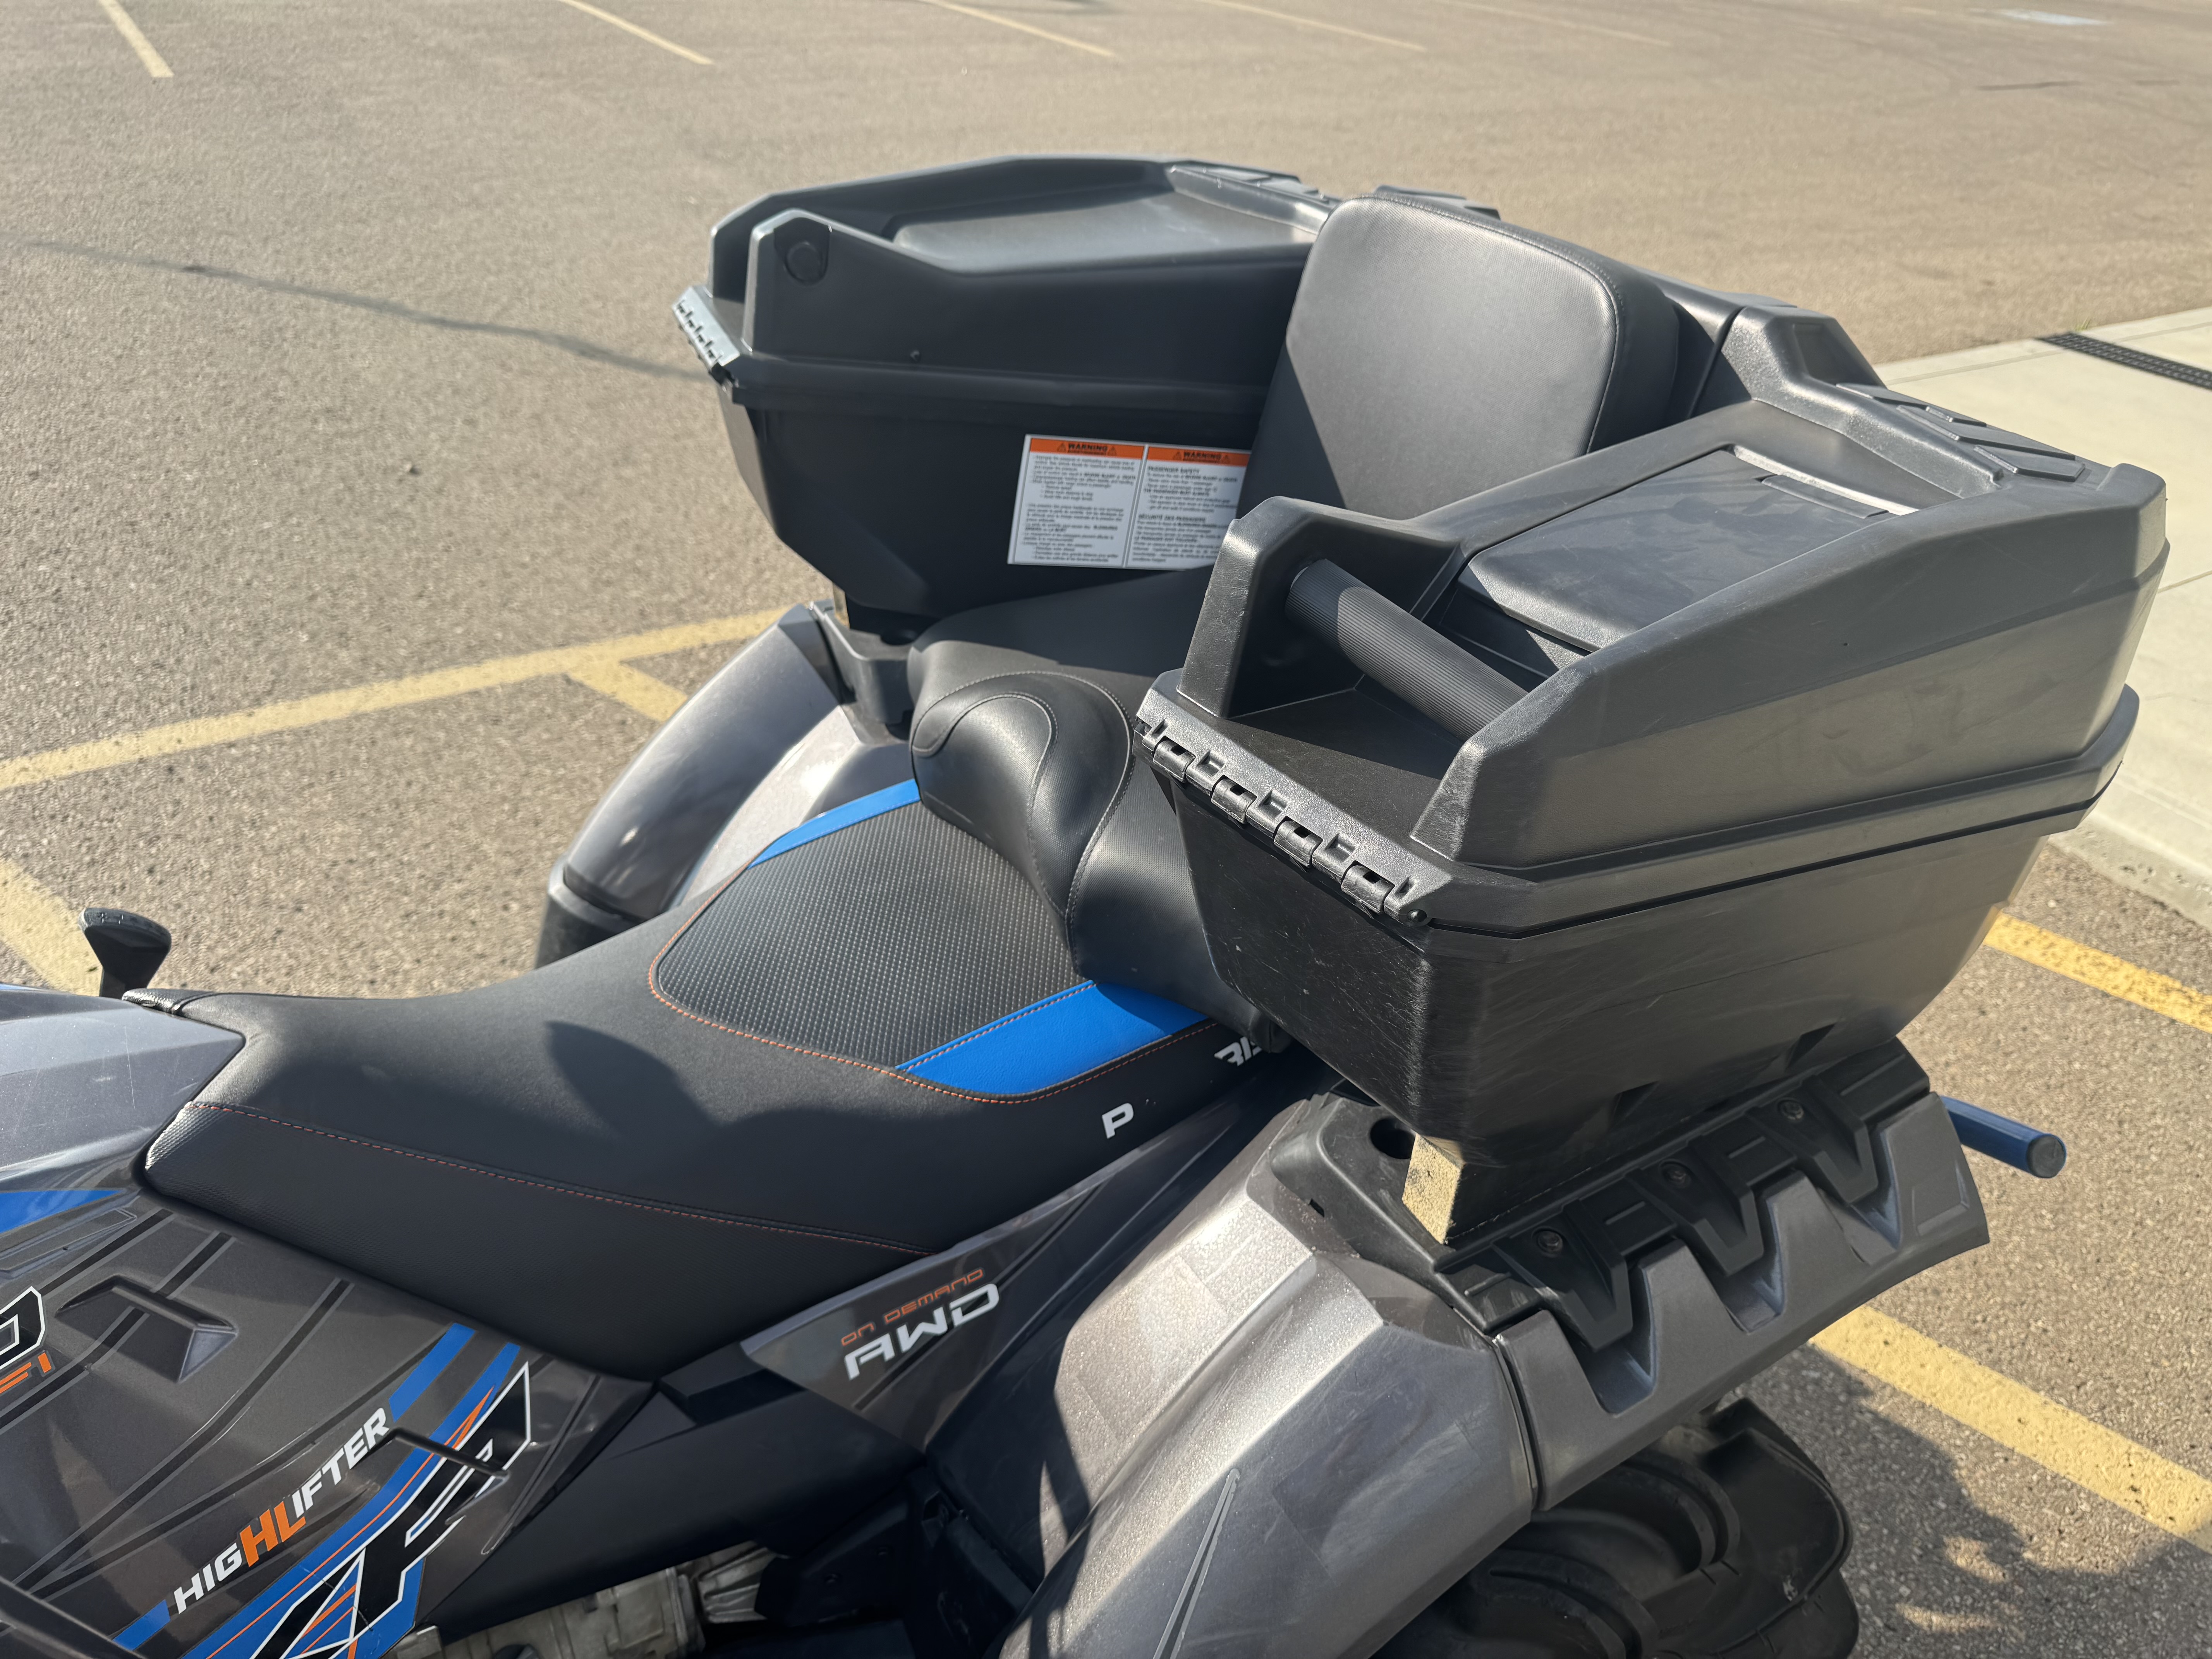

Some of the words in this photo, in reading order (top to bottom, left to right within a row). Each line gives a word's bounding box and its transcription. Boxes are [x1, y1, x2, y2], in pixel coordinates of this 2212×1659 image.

[1068, 443, 1108, 451] WARNING
[1183, 451, 1222, 459] WARNING
[844, 1283, 1000, 1380] AWD
